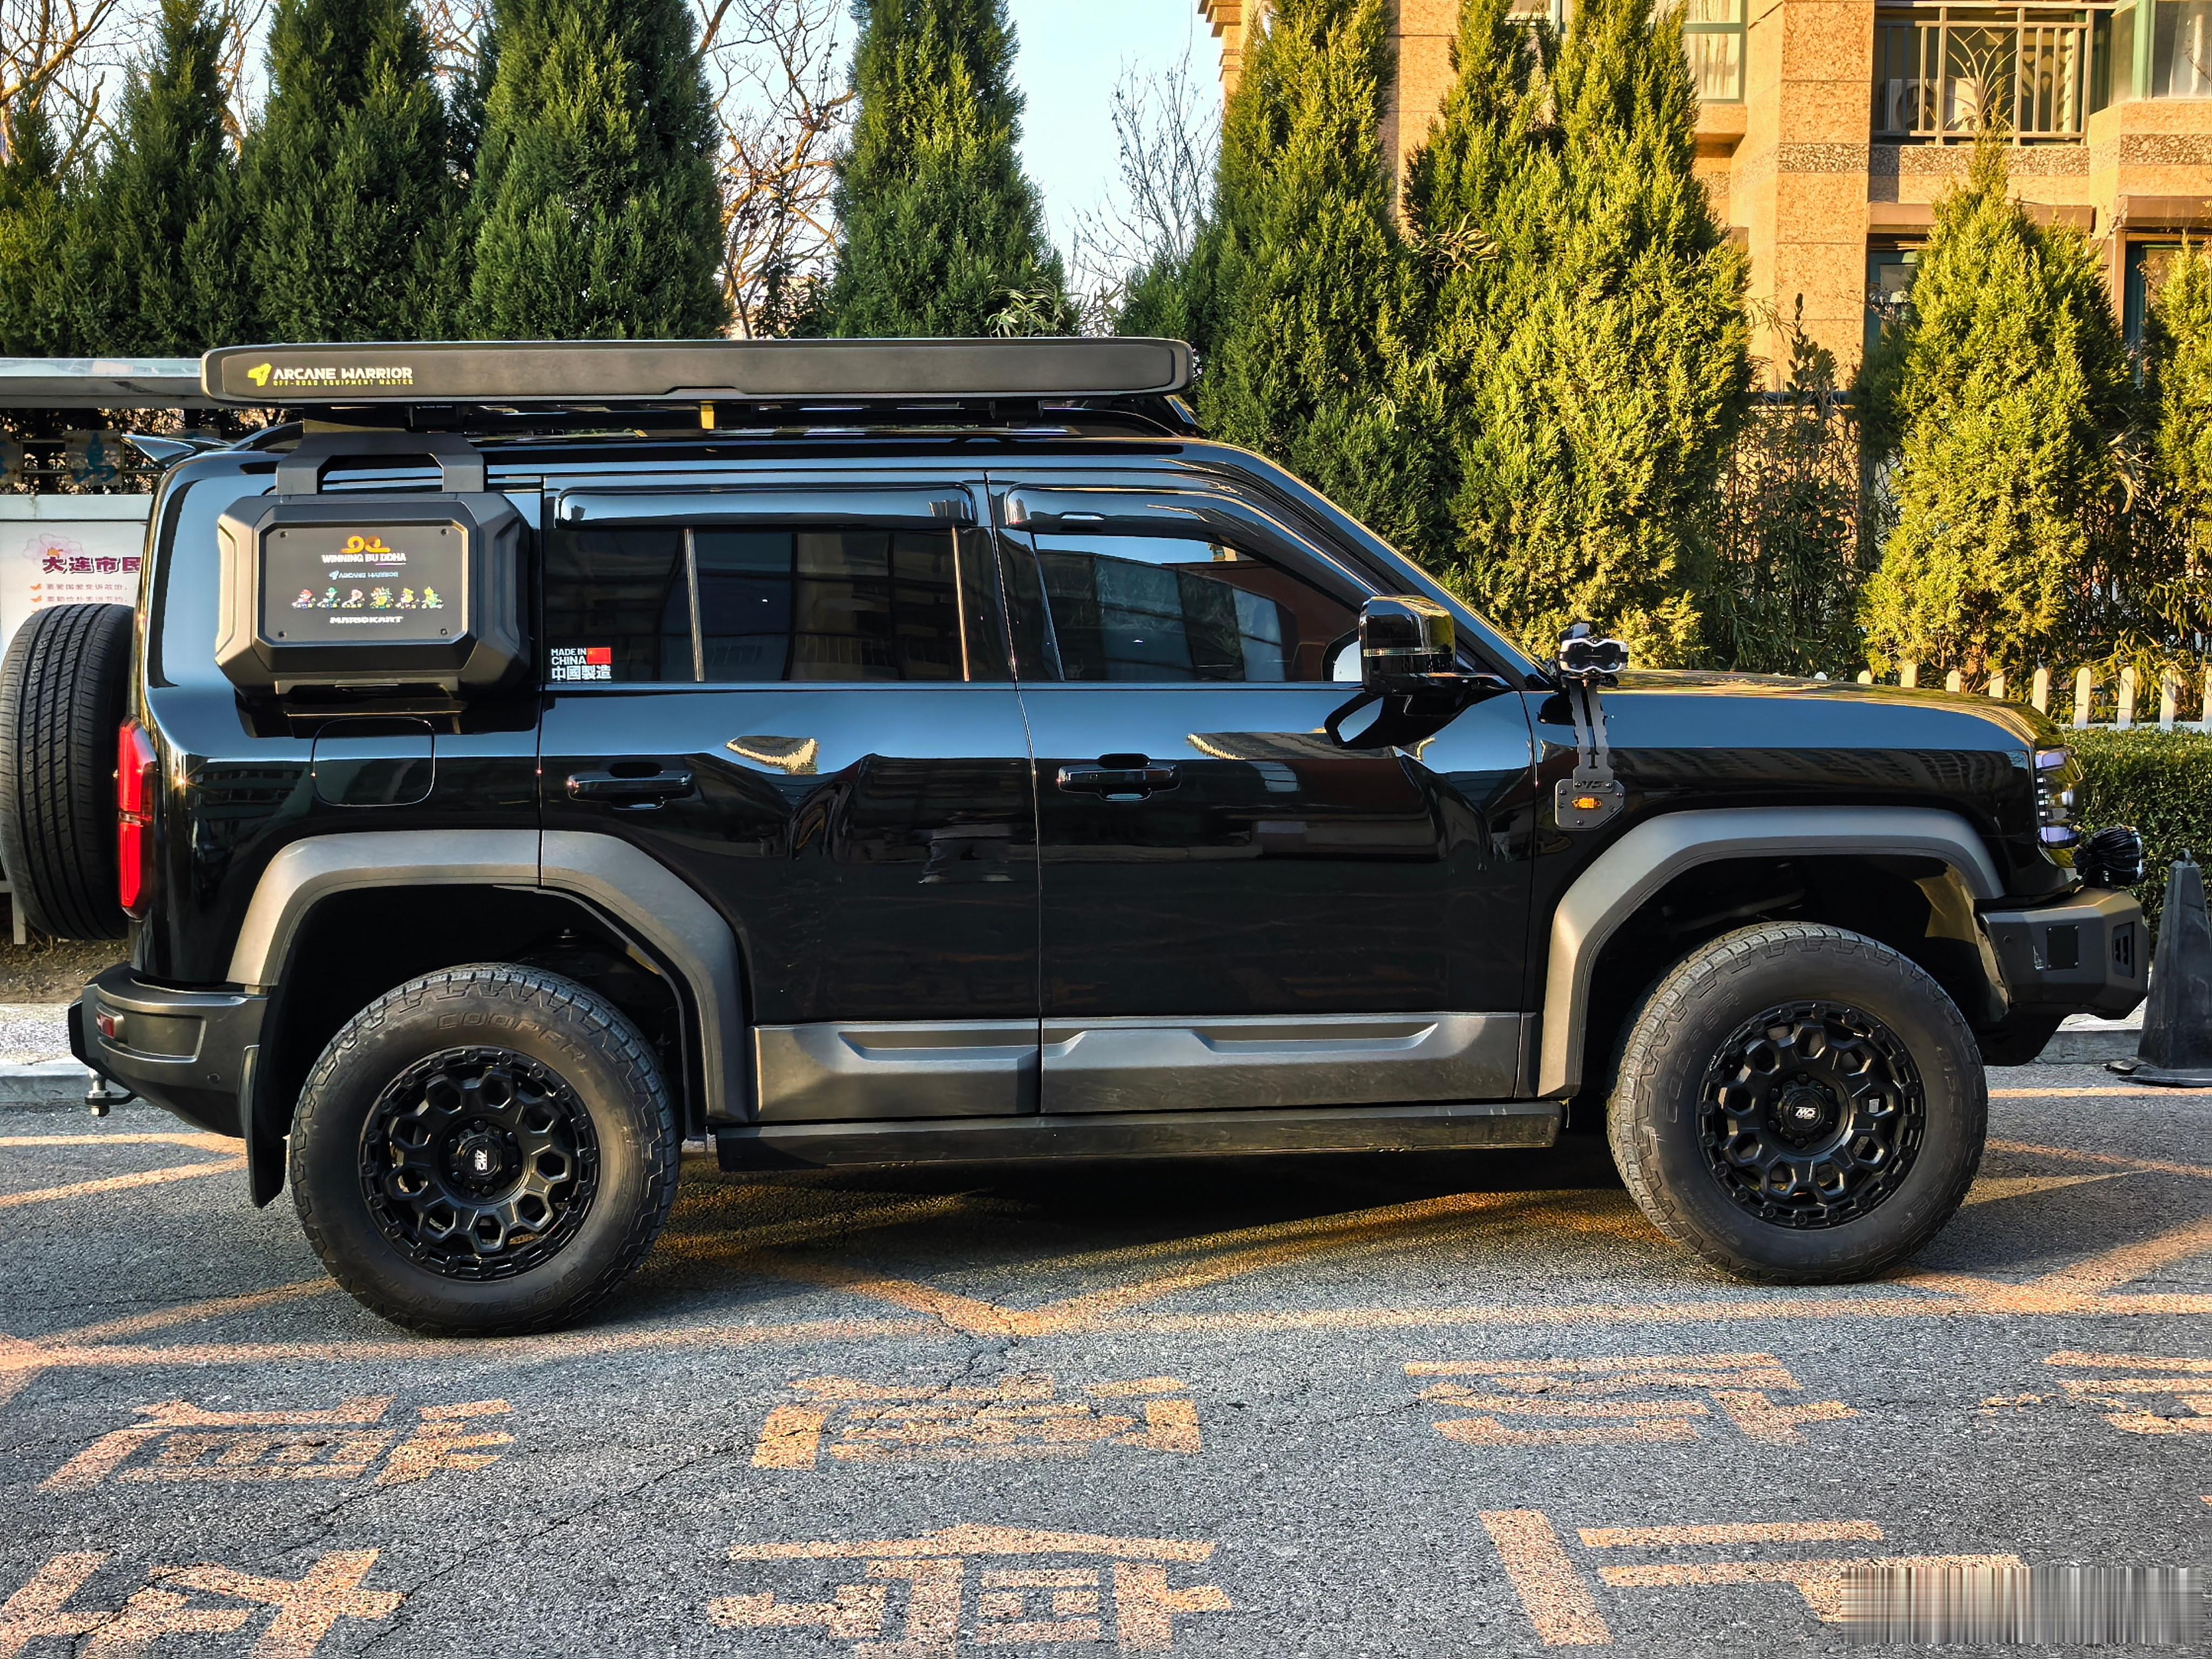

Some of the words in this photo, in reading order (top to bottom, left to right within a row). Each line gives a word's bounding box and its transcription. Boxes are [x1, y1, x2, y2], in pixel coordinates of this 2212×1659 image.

[273, 367, 336, 380] ARCANE
[341, 367, 413, 379] WARRIOR
[42, 556, 141, 574] 大连市民
[322, 554, 364, 563] WINNING
[551, 648, 577, 656] MADE
[551, 656, 587, 665] CHINA
[551, 664, 612, 680] 中國製造
[436, 1011, 587, 1063] COOPER
